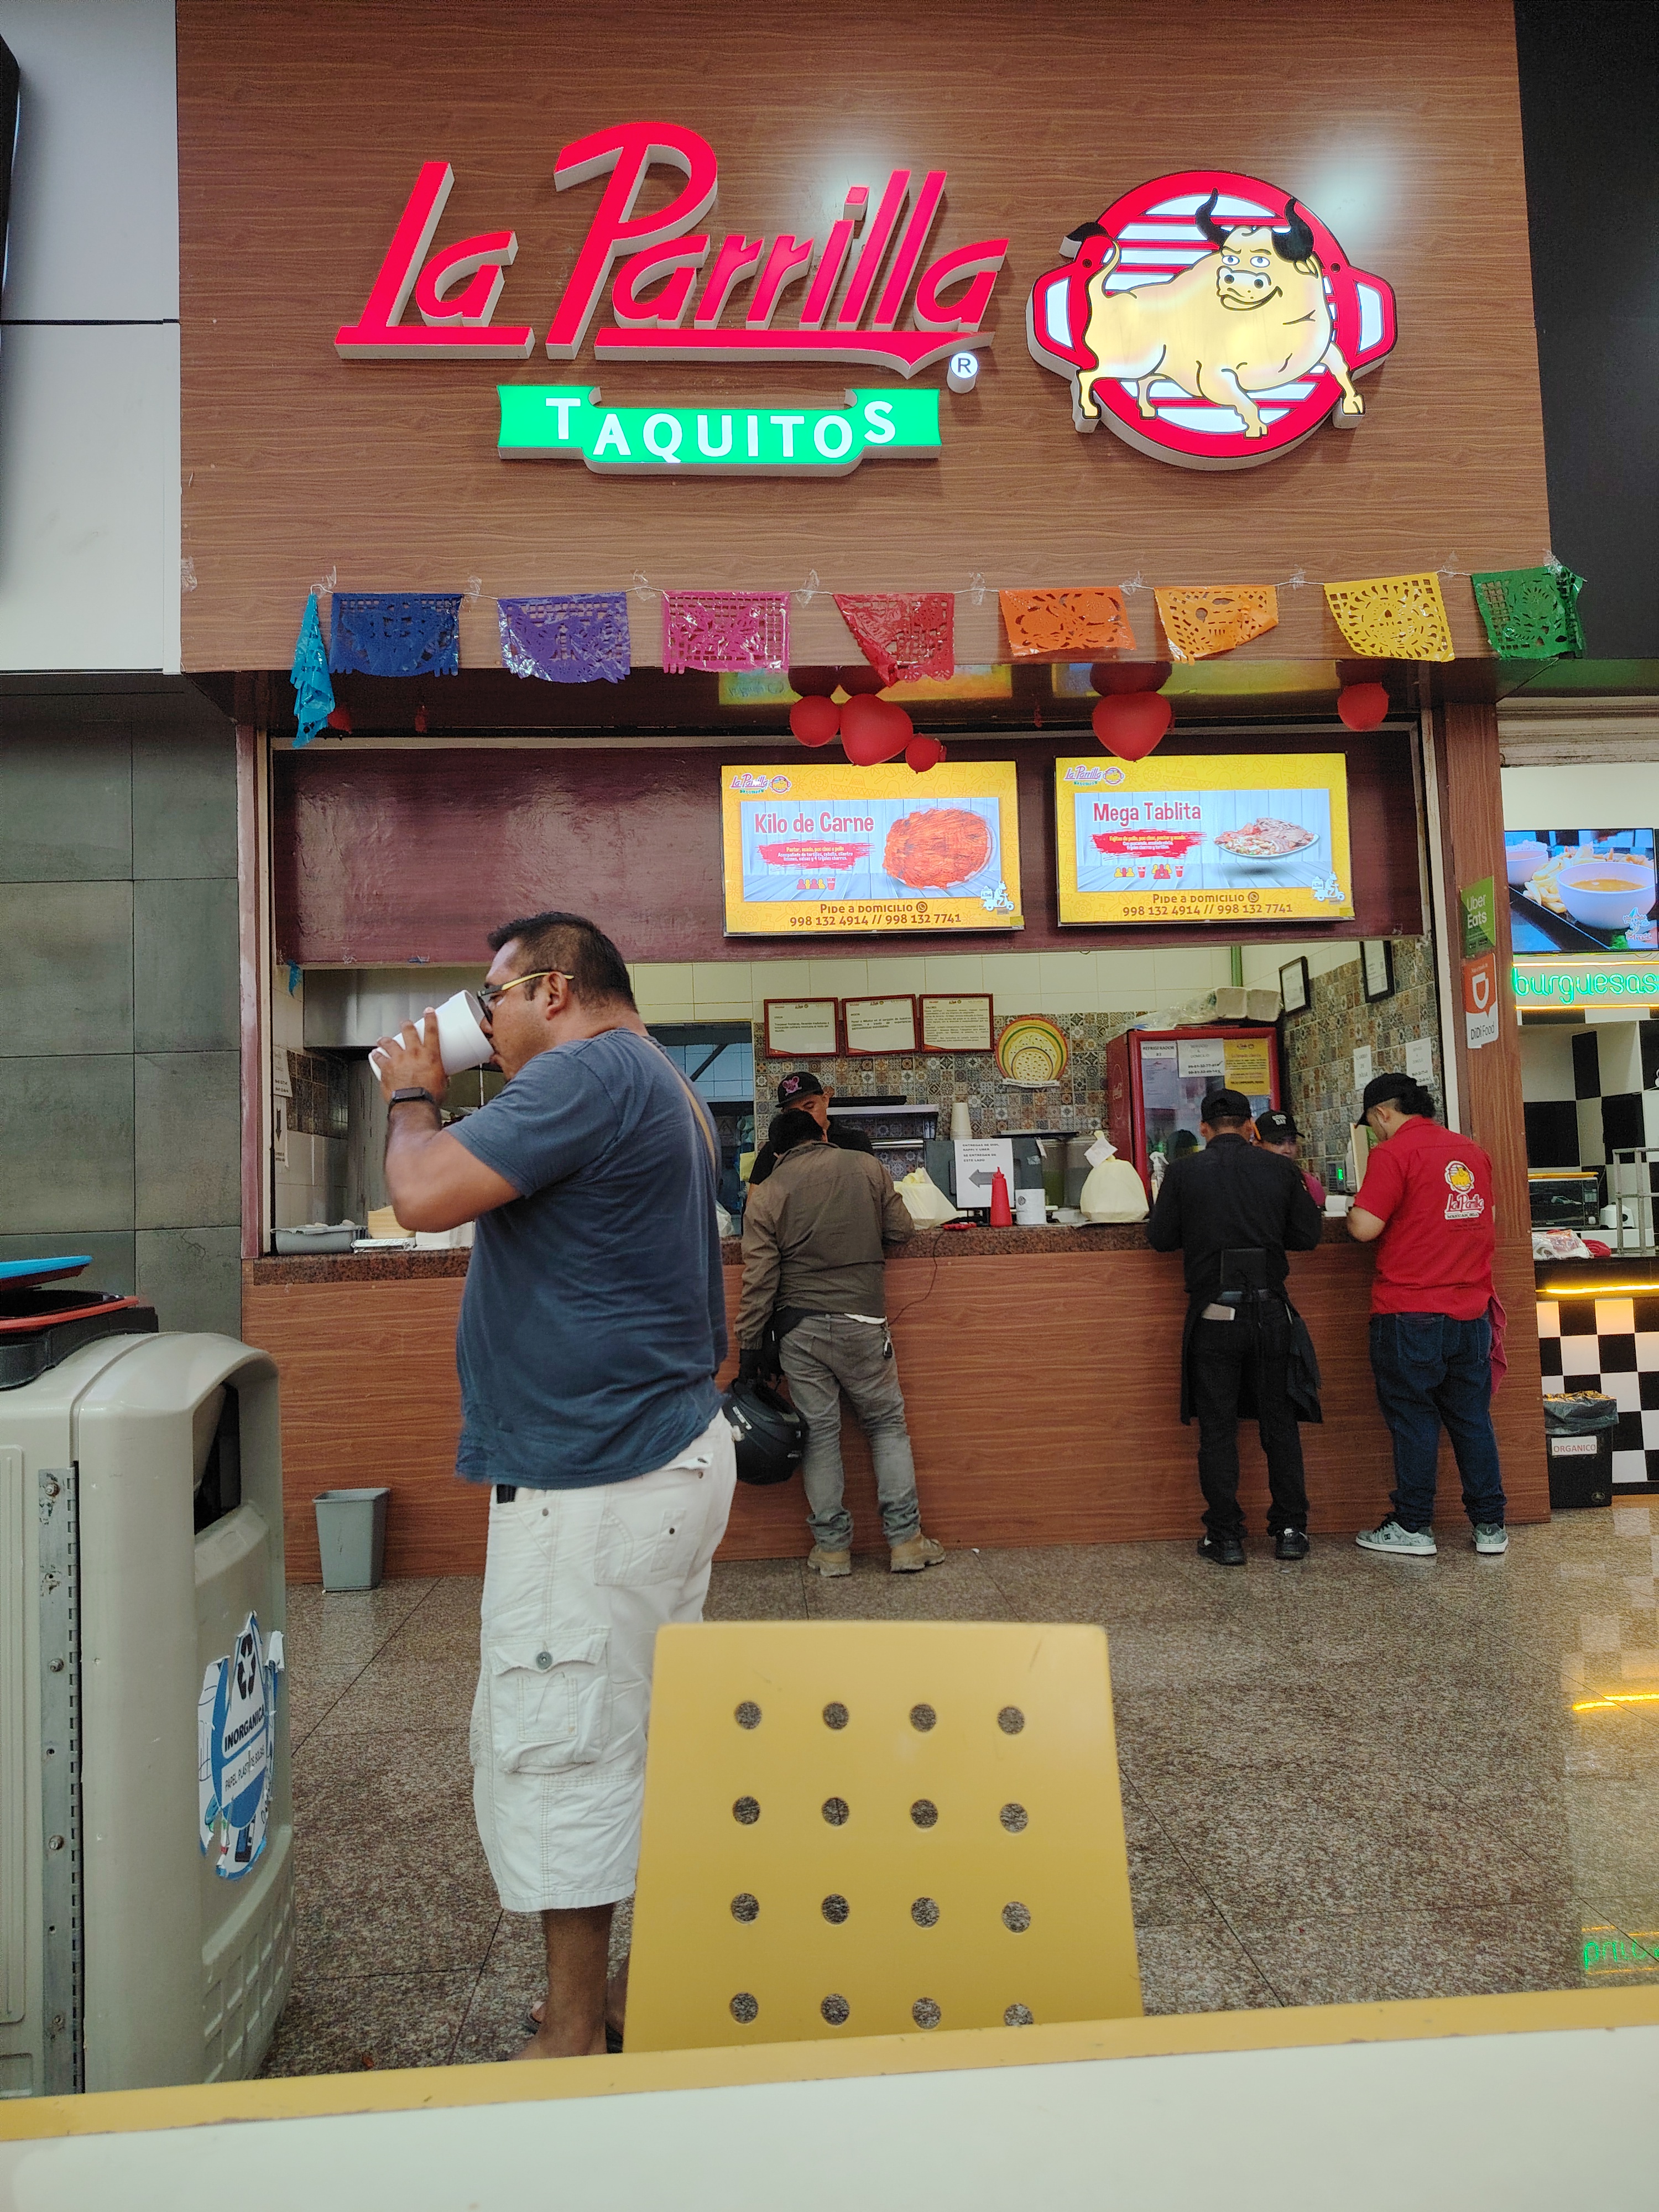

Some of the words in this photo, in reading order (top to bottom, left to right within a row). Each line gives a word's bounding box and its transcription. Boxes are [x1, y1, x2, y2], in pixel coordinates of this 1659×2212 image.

[335, 160, 535, 359] La
[546, 121, 1009, 379] Parrilla
[545, 397, 897, 464] TAQUITOS
[755, 813, 787, 833] Kilo
[793, 813, 814, 833] de
[820, 812, 874, 833] Carne
[1093, 802, 1139, 827] Mega
[1144, 801, 1201, 820] Tablita
[1123, 906, 1144, 916] 998
[1148, 906, 1167, 915] 132
[1171, 906, 1200, 916] 4914
[1218, 904, 1239, 915] 998
[1243, 904, 1262, 914] 132
[1266, 904, 1292, 914] 7741
[1467, 894, 1486, 912] Uber
[790, 916, 812, 927] 998
[816, 916, 836, 926] 132
[839, 915, 868, 925] 4914
[885, 914, 907, 925] 998
[911, 914, 931, 924] 132
[935, 914, 961, 923] 7741
[1467, 911, 1487, 929] Eats
[1471, 1025, 1482, 1040] DiDi
[1482, 1021, 1494, 1037] Food
[1553, 1444, 1596, 1452] ORGANICO
